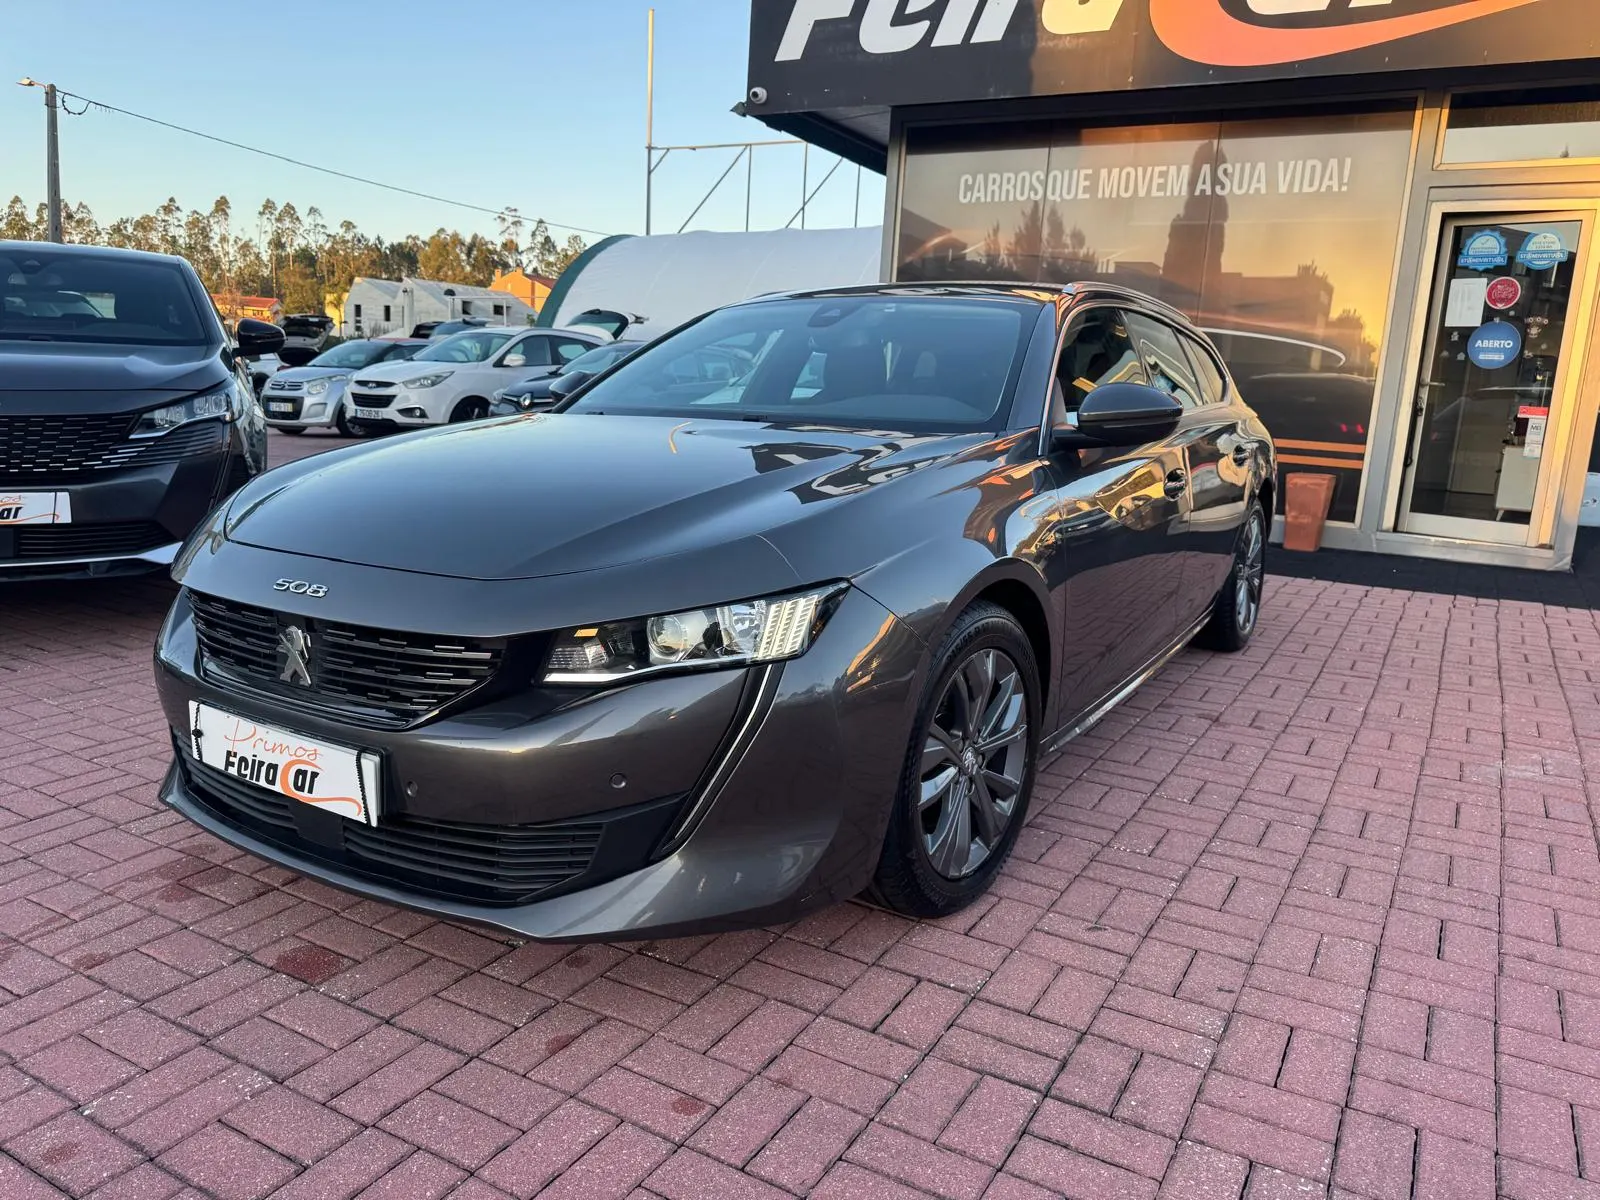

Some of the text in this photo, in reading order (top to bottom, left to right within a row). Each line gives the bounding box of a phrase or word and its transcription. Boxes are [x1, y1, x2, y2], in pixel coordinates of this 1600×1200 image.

[958, 157, 1352, 204] CARROS QUE MOVEM A SUA VIDA!
[1475, 340, 1513, 348] ABERTO
[272, 578, 329, 598] 508
[224, 719, 323, 761] Primos
[224, 749, 326, 803] FeiraCar
